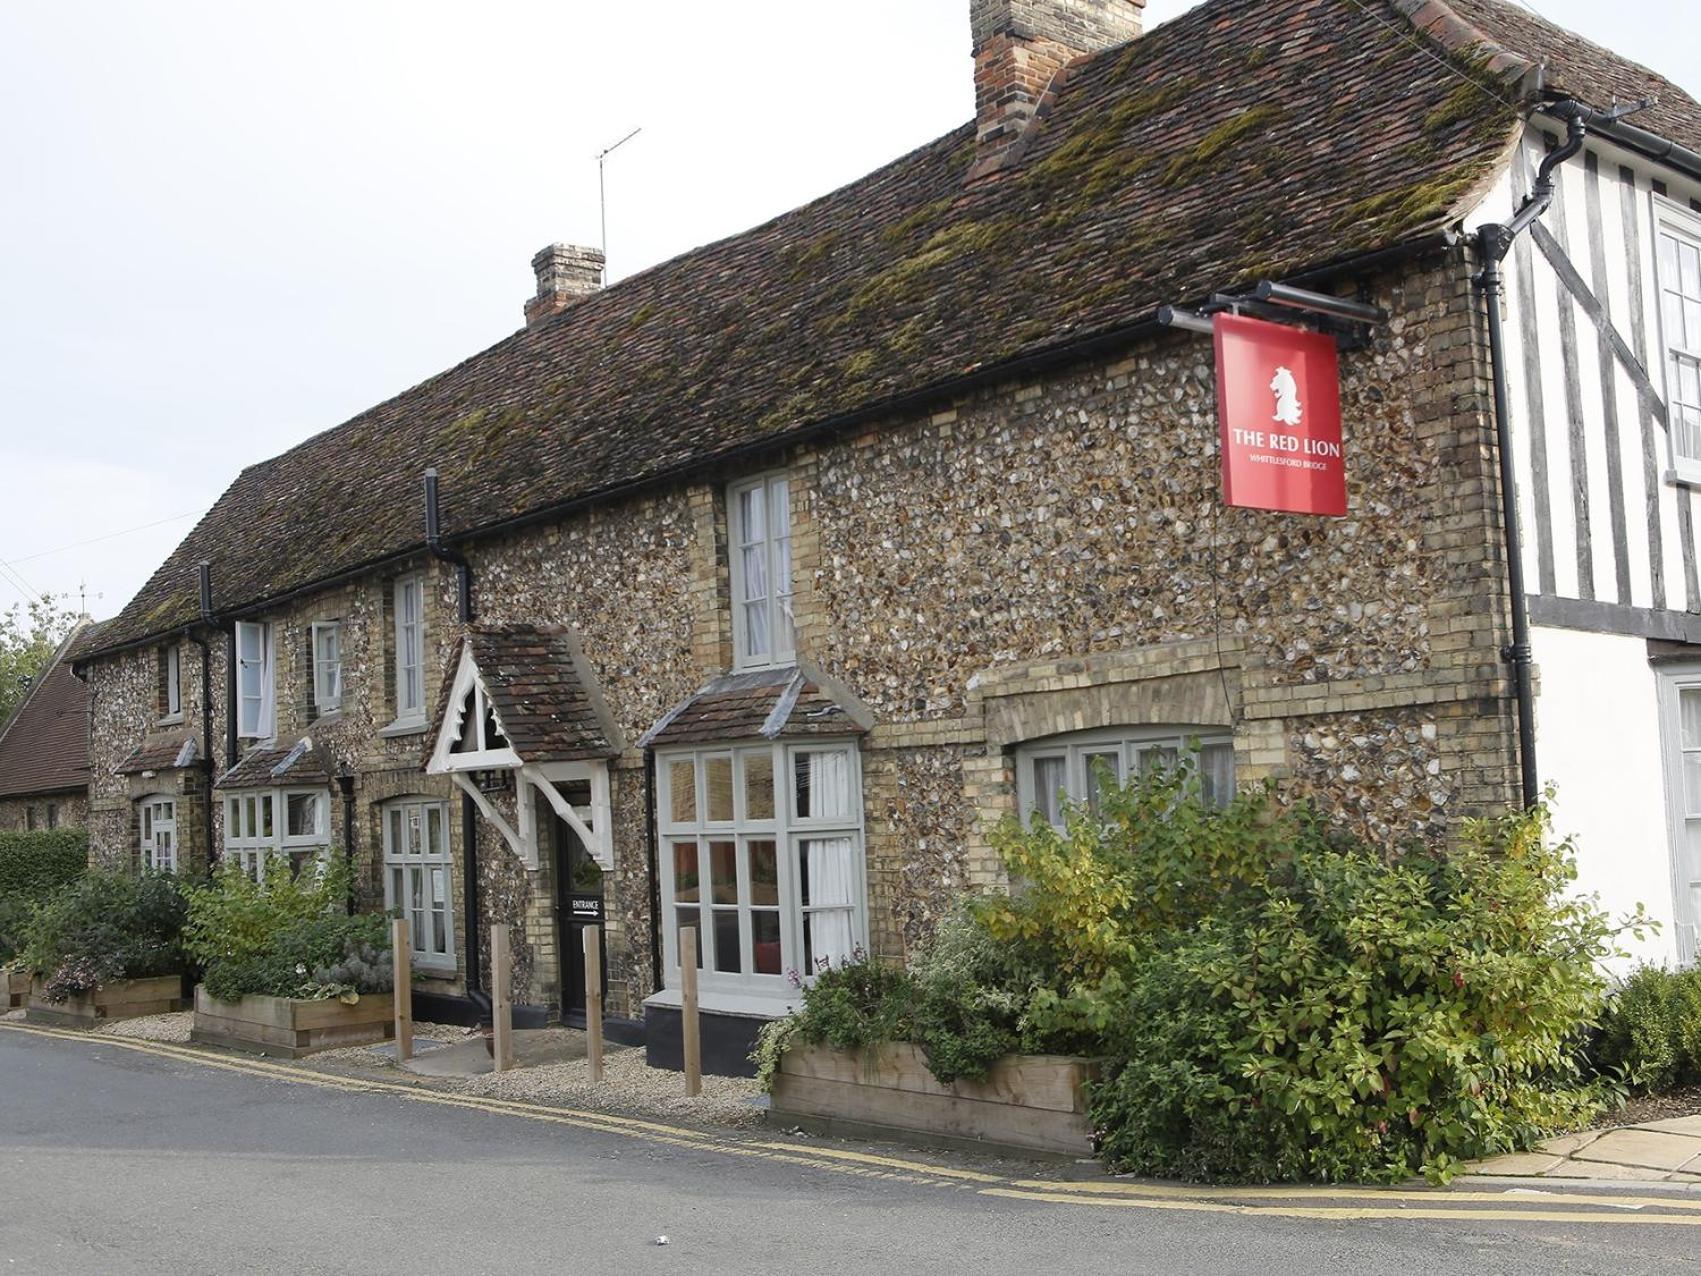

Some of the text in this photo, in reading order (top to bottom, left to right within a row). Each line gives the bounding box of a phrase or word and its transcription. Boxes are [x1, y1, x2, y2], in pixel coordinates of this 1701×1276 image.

[1233, 428, 1340, 458] THE RED LION
[1249, 454, 1327, 471] WHITTLESFORD BRIDGE
[572, 900, 599, 910] ENTRANCE
